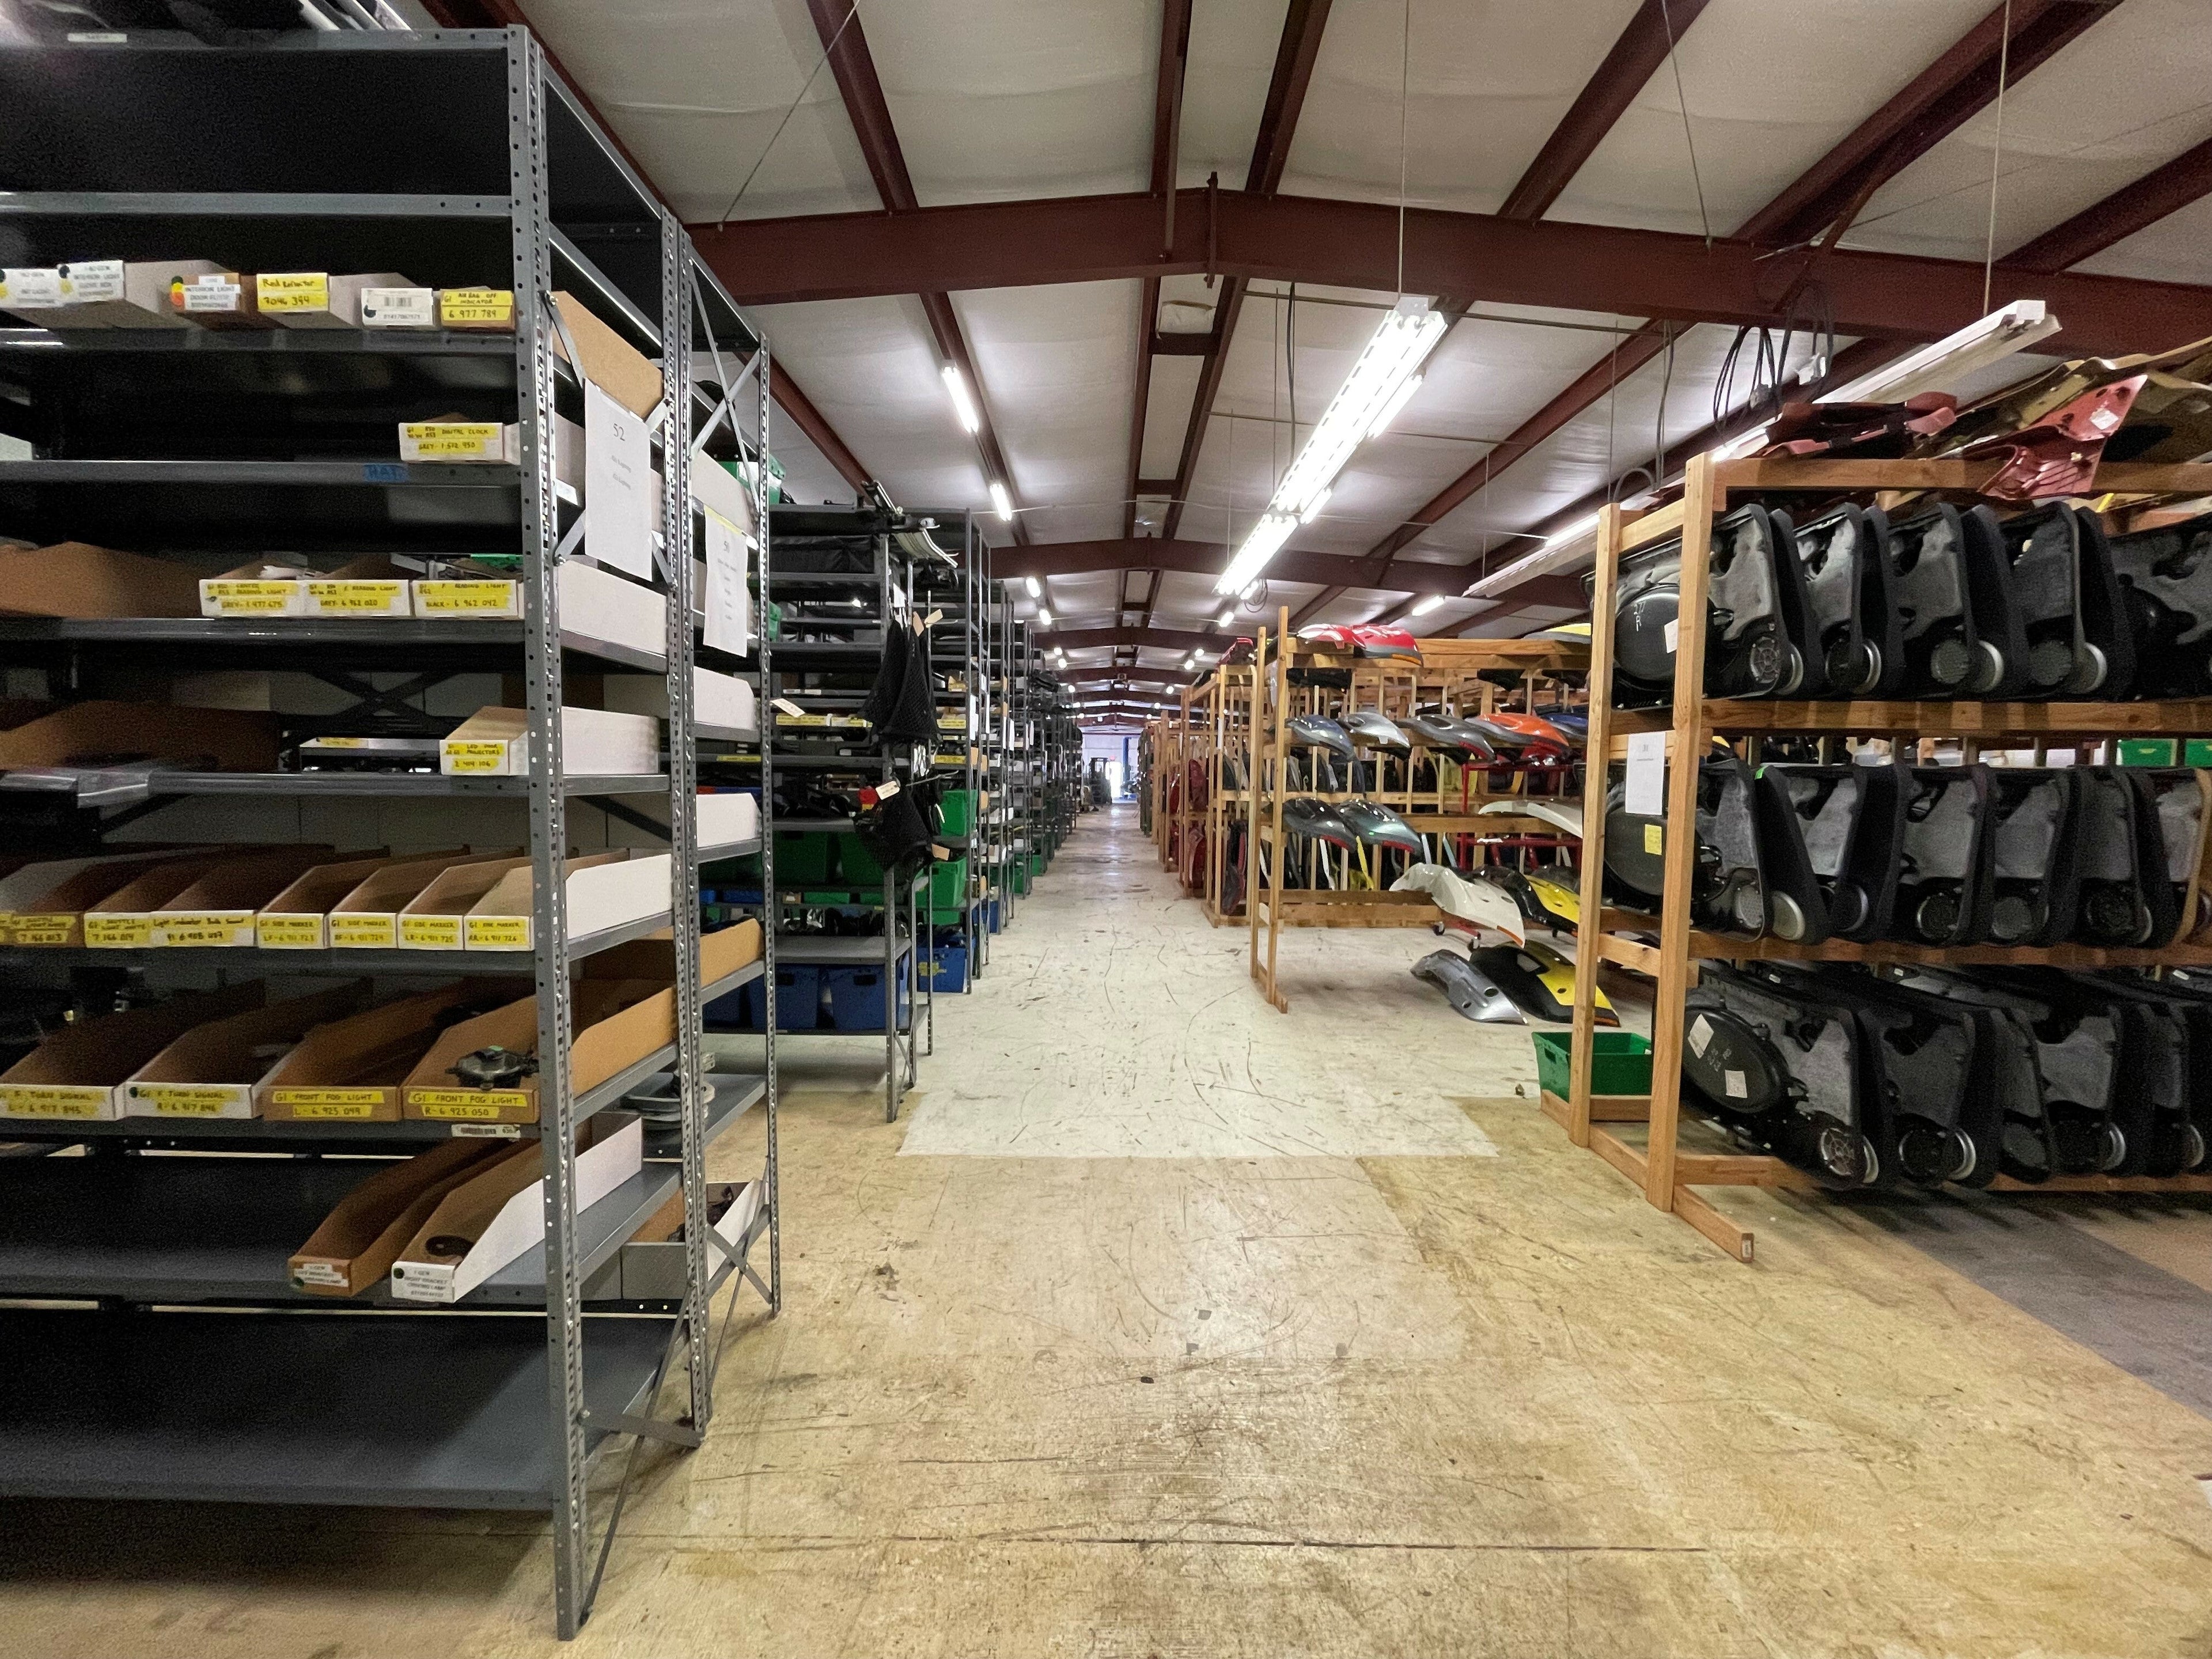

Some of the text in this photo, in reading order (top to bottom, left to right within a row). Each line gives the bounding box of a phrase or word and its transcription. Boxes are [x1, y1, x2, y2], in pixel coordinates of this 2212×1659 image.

[263, 278, 281, 287] Red
[449, 310, 454, 318] 6
[460, 310, 477, 318] 977
[613, 423, 626, 442] 52
[414, 1093, 426, 1102] G1
[469, 1095, 486, 1103] FOG
